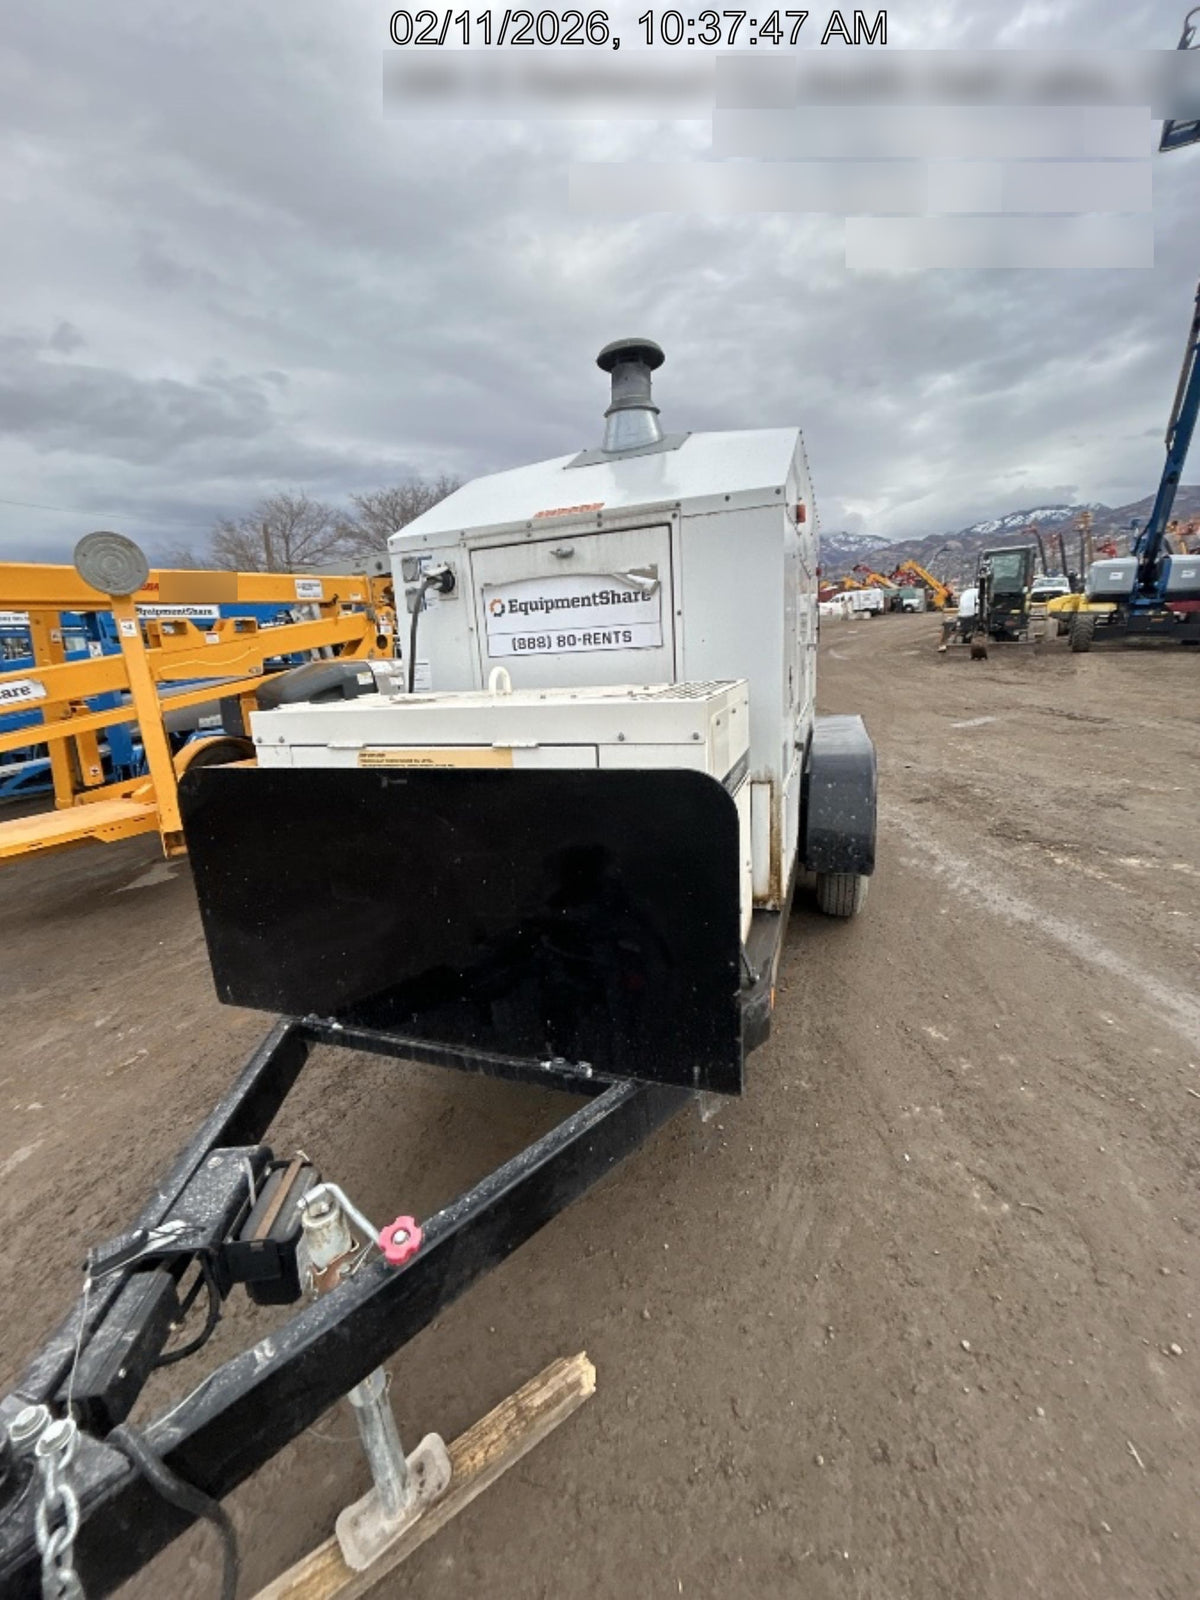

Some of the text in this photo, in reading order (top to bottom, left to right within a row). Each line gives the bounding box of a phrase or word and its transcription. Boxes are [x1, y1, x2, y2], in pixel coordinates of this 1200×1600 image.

[508, 589, 652, 616] EquipmentShare
[512, 630, 632, 651] (888) 80-RENTS
[0, 685, 31, 699] are
